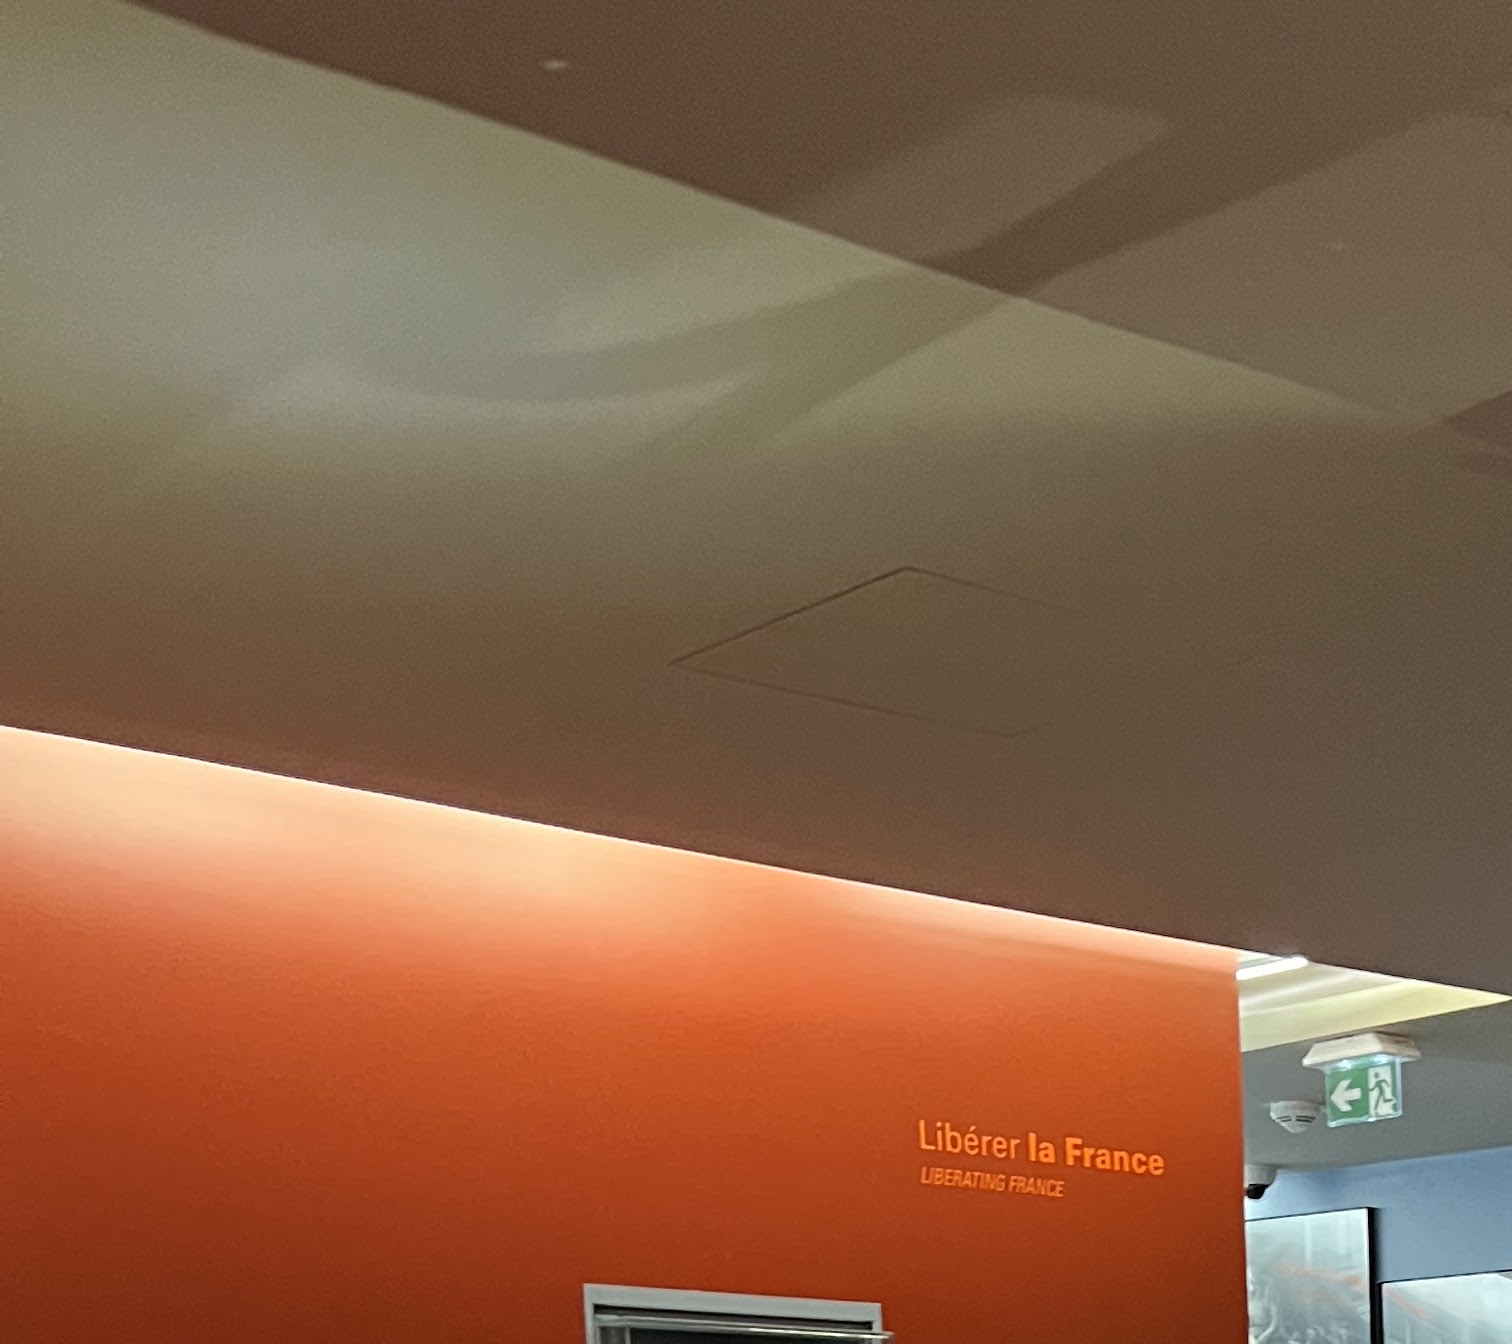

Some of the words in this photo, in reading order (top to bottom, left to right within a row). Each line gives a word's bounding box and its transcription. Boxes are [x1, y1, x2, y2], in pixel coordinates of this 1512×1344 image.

[918, 1119, 1021, 1160] Libérer
[1027, 1132, 1056, 1164] la
[1065, 1137, 1166, 1176] France
[920, 1166, 1006, 1191] LIBERATING
[1008, 1174, 1065, 1198] FRANCE
